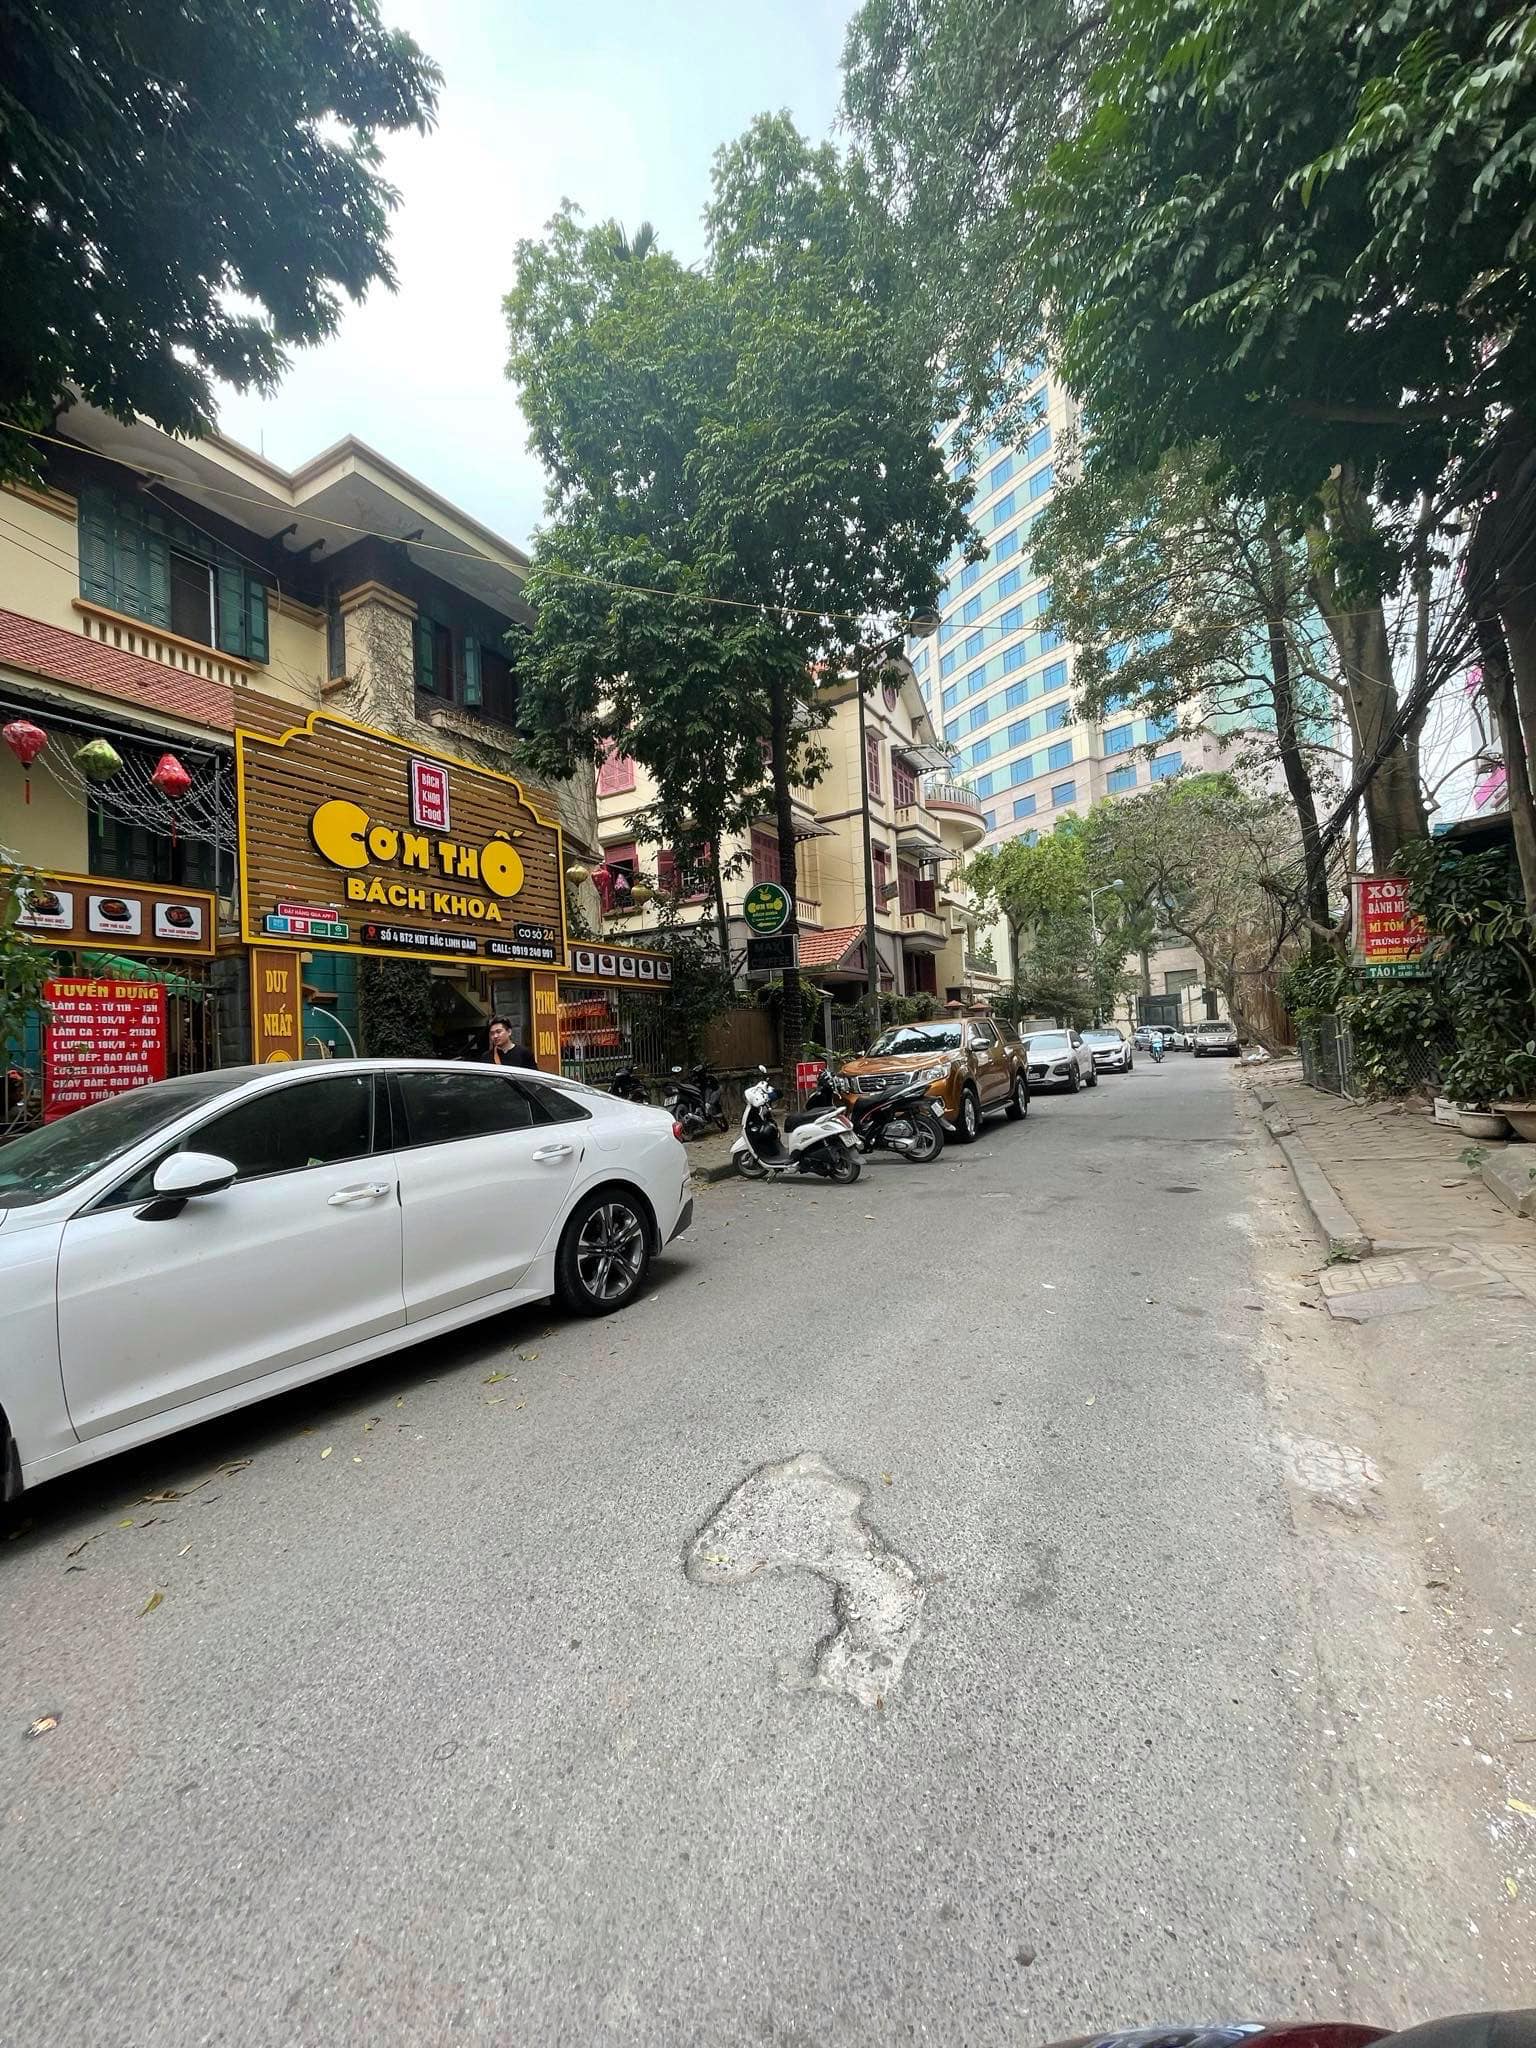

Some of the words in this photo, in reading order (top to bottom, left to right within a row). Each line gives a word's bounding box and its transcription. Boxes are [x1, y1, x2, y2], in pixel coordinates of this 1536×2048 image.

[421, 772, 440, 789] BÁCH
[422, 789, 441, 806] KHOA
[422, 804, 442, 822] Food
[312, 799, 430, 870] CƠM
[438, 829, 526, 898] THỐ
[347, 876, 426, 910] BÁCH
[433, 892, 502, 922] KHOA
[1368, 899, 1393, 915] BÁNH
[380, 928, 392, 941] SỐ
[393, 931, 398, 942] 4
[445, 937, 461, 949] LINH
[543, 929, 554, 941] 24
[491, 942, 511, 954] CALL:
[511, 945, 529, 956] 0919
[265, 970, 288, 993] DUY
[53, 981, 109, 998] TUYỂN
[115, 986, 159, 1000] DỤNG
[52, 1001, 75, 1011] LÀM
[78, 1002, 92, 1011] CA
[116, 1003, 131, 1012] 11H
[142, 1004, 158, 1013] 15H
[535, 990, 556, 1015] TINH
[263, 1003, 293, 1037] NHẤT
[52, 1027, 76, 1037] LÀM
[79, 1028, 93, 1037] CA
[102, 1028, 118, 1037] 17H
[129, 1028, 157, 1037] 21H30
[539, 1031, 557, 1056] HOA
[103, 1053, 123, 1061] BAO
[110, 1077, 129, 1086] BAO
